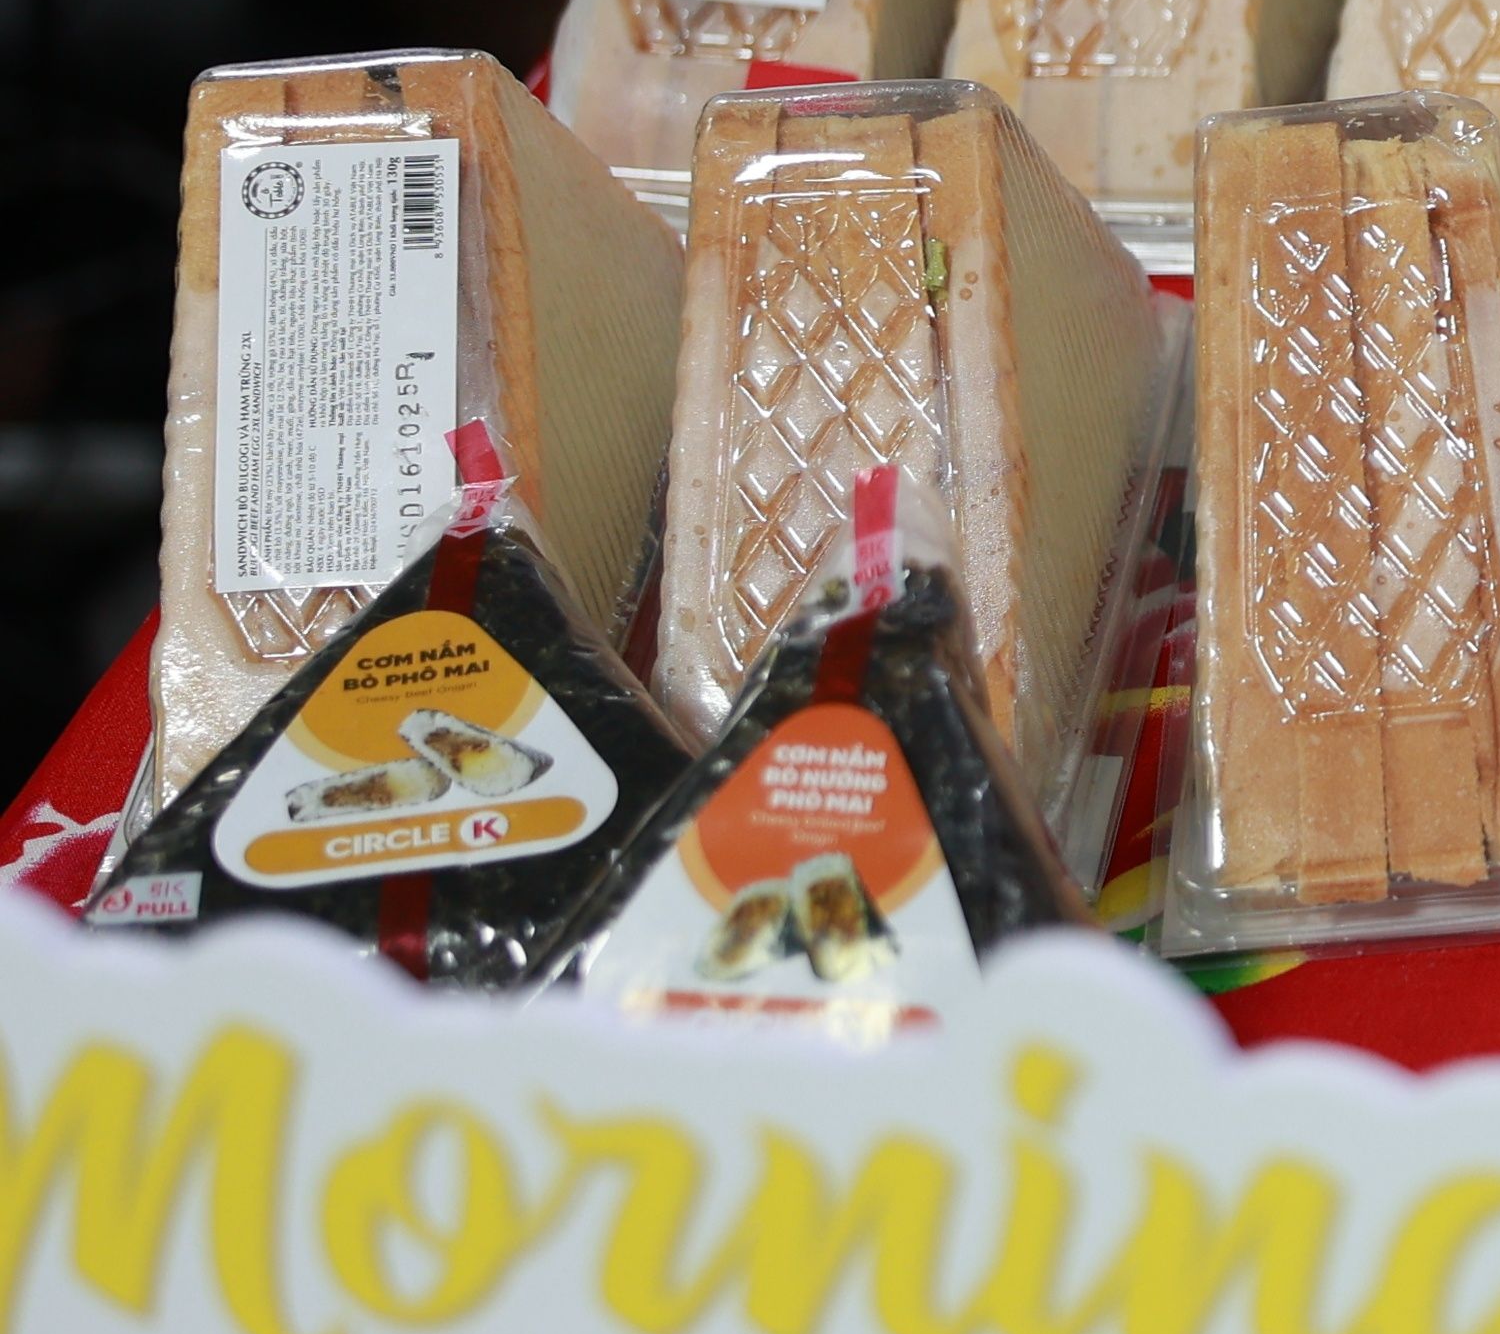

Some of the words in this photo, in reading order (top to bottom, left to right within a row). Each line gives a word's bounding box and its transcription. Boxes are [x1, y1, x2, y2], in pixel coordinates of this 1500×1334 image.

[387, 156, 400, 184] 130g
[435, 157, 444, 198] 530531
[434, 205, 444, 244] 936087
[241, 331, 251, 349] 2XL
[238, 353, 250, 390] TRỨNG
[252, 361, 261, 414] SANDWICH
[239, 394, 250, 420] HAM
[238, 424, 249, 438] VÀ
[251, 416, 260, 432] 2XL
[251, 435, 259, 456] EGG
[237, 443, 249, 491] BULGOGI
[250, 458, 259, 481] HAM
[237, 495, 248, 510] BÒ
[250, 483, 259, 505] AND
[250, 507, 258, 529] BEEF
[236, 513, 248, 577] SANDWICH
[357, 652, 414, 672] CƠM
[420, 640, 476, 664] NẮM
[343, 674, 379, 693] BÒ
[385, 668, 438, 687] PHÔ
[443, 660, 490, 679] MAI
[773, 744, 828, 766] CƠM
[825, 793, 874, 815] MAI
[325, 823, 450, 860] CIRCLE
[472, 817, 504, 842] K
[137, 901, 191, 917] PULL
